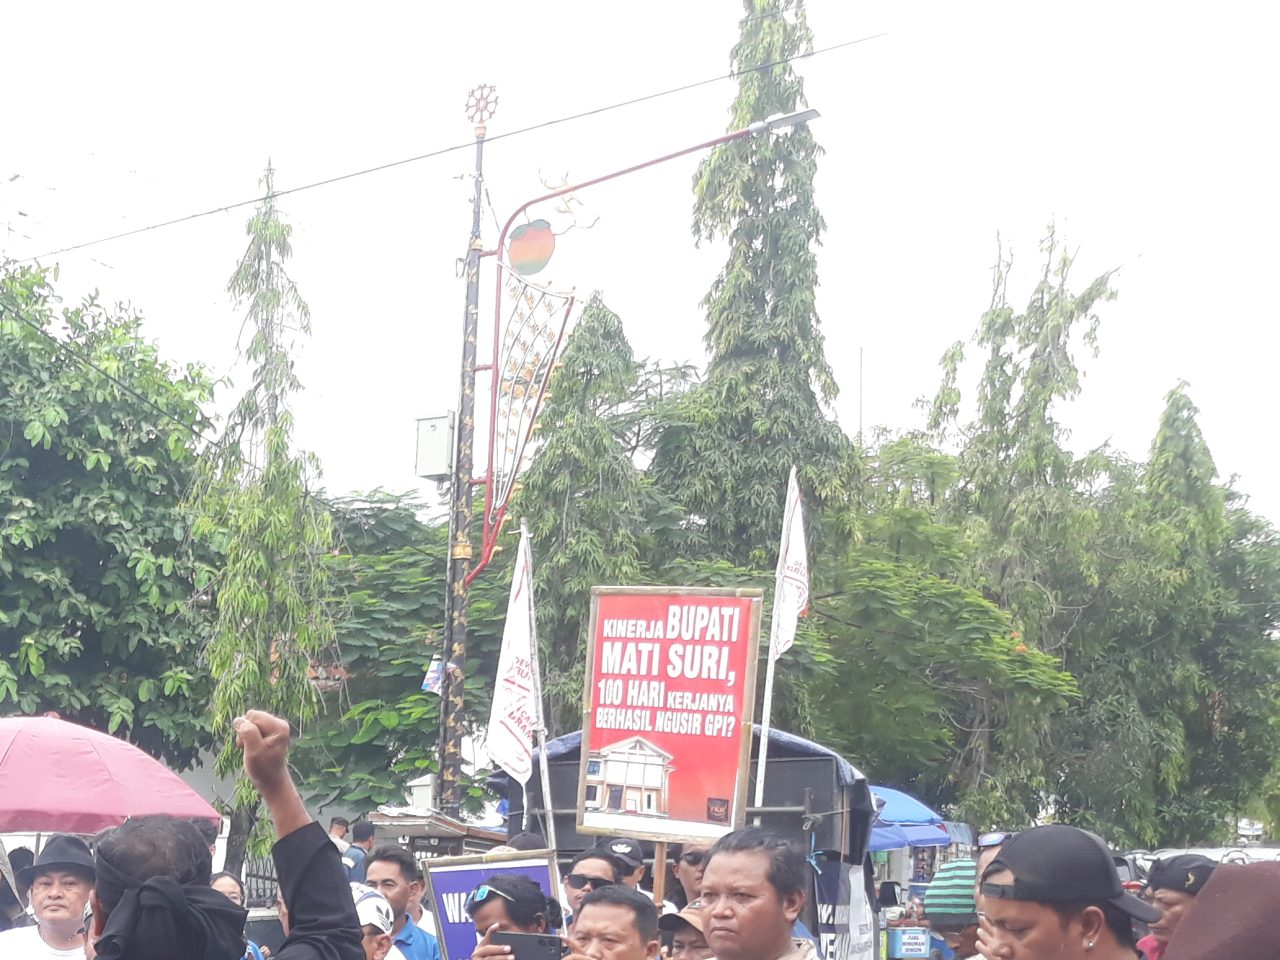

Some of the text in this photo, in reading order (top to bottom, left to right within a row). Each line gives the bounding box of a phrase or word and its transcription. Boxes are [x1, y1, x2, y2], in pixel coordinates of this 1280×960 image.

[603, 605, 740, 642] KINERJA BUPATI
[601, 641, 735, 687] MATI SURI,
[598, 679, 734, 712] 100 HARI KERJANYA
[596, 707, 736, 737] BERHASIL NGUSIR GPI?
